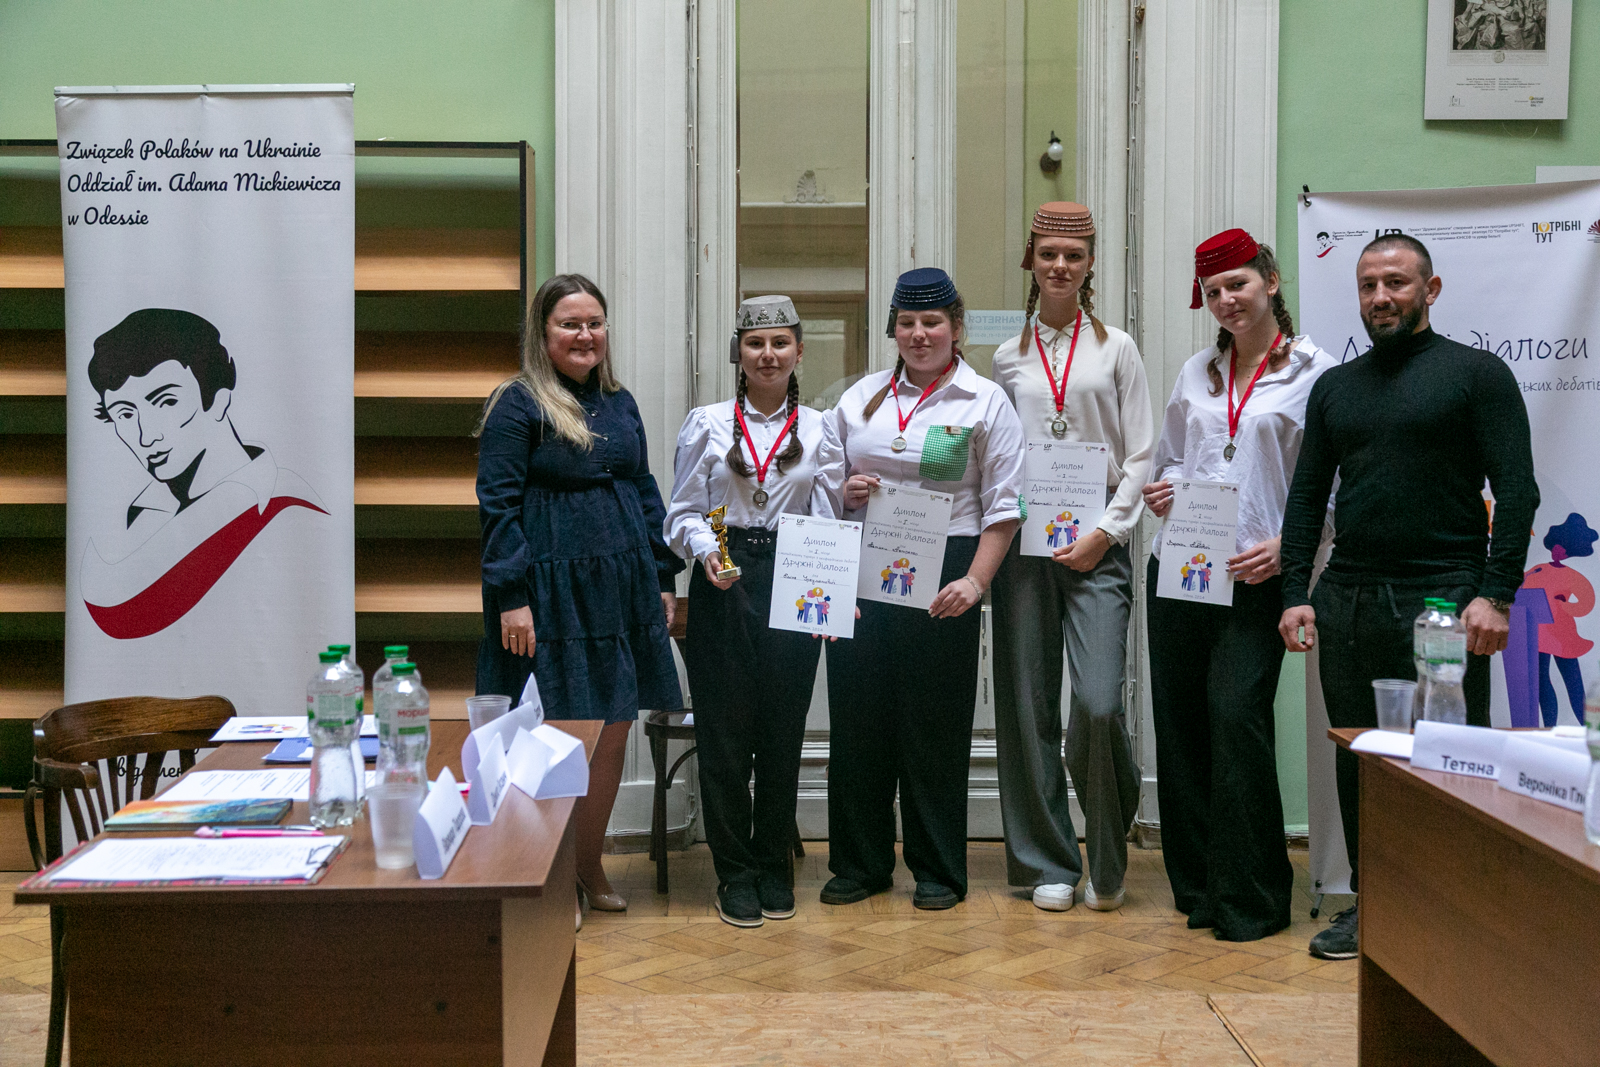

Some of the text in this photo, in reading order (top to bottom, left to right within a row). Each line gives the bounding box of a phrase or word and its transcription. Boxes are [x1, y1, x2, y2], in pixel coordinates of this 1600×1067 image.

[67, 138, 322, 163] Związek Polaków na Ukrainie
[67, 170, 341, 192] Oddział im. Adama Mickiewicza
[68, 204, 149, 226] w Odessie
[1532, 220, 1580, 232] ПОТРІБНІ
[1535, 232, 1553, 243] ТУТ
[1051, 461, 1084, 472] Диплом
[1031, 484, 1096, 495] Дружні діалоги
[1188, 501, 1218, 511] Диплом
[893, 507, 926, 518] Диплом
[871, 527, 902, 538] Дружні
[904, 532, 937, 544] діалоги
[1170, 524, 1198, 534] Дружні
[1200, 526, 1229, 537] діалоги
[803, 537, 837, 547] Диплом
[782, 558, 814, 568] Дружні
[816, 561, 849, 572] діалоги
[1441, 755, 1494, 776] Тетяна
